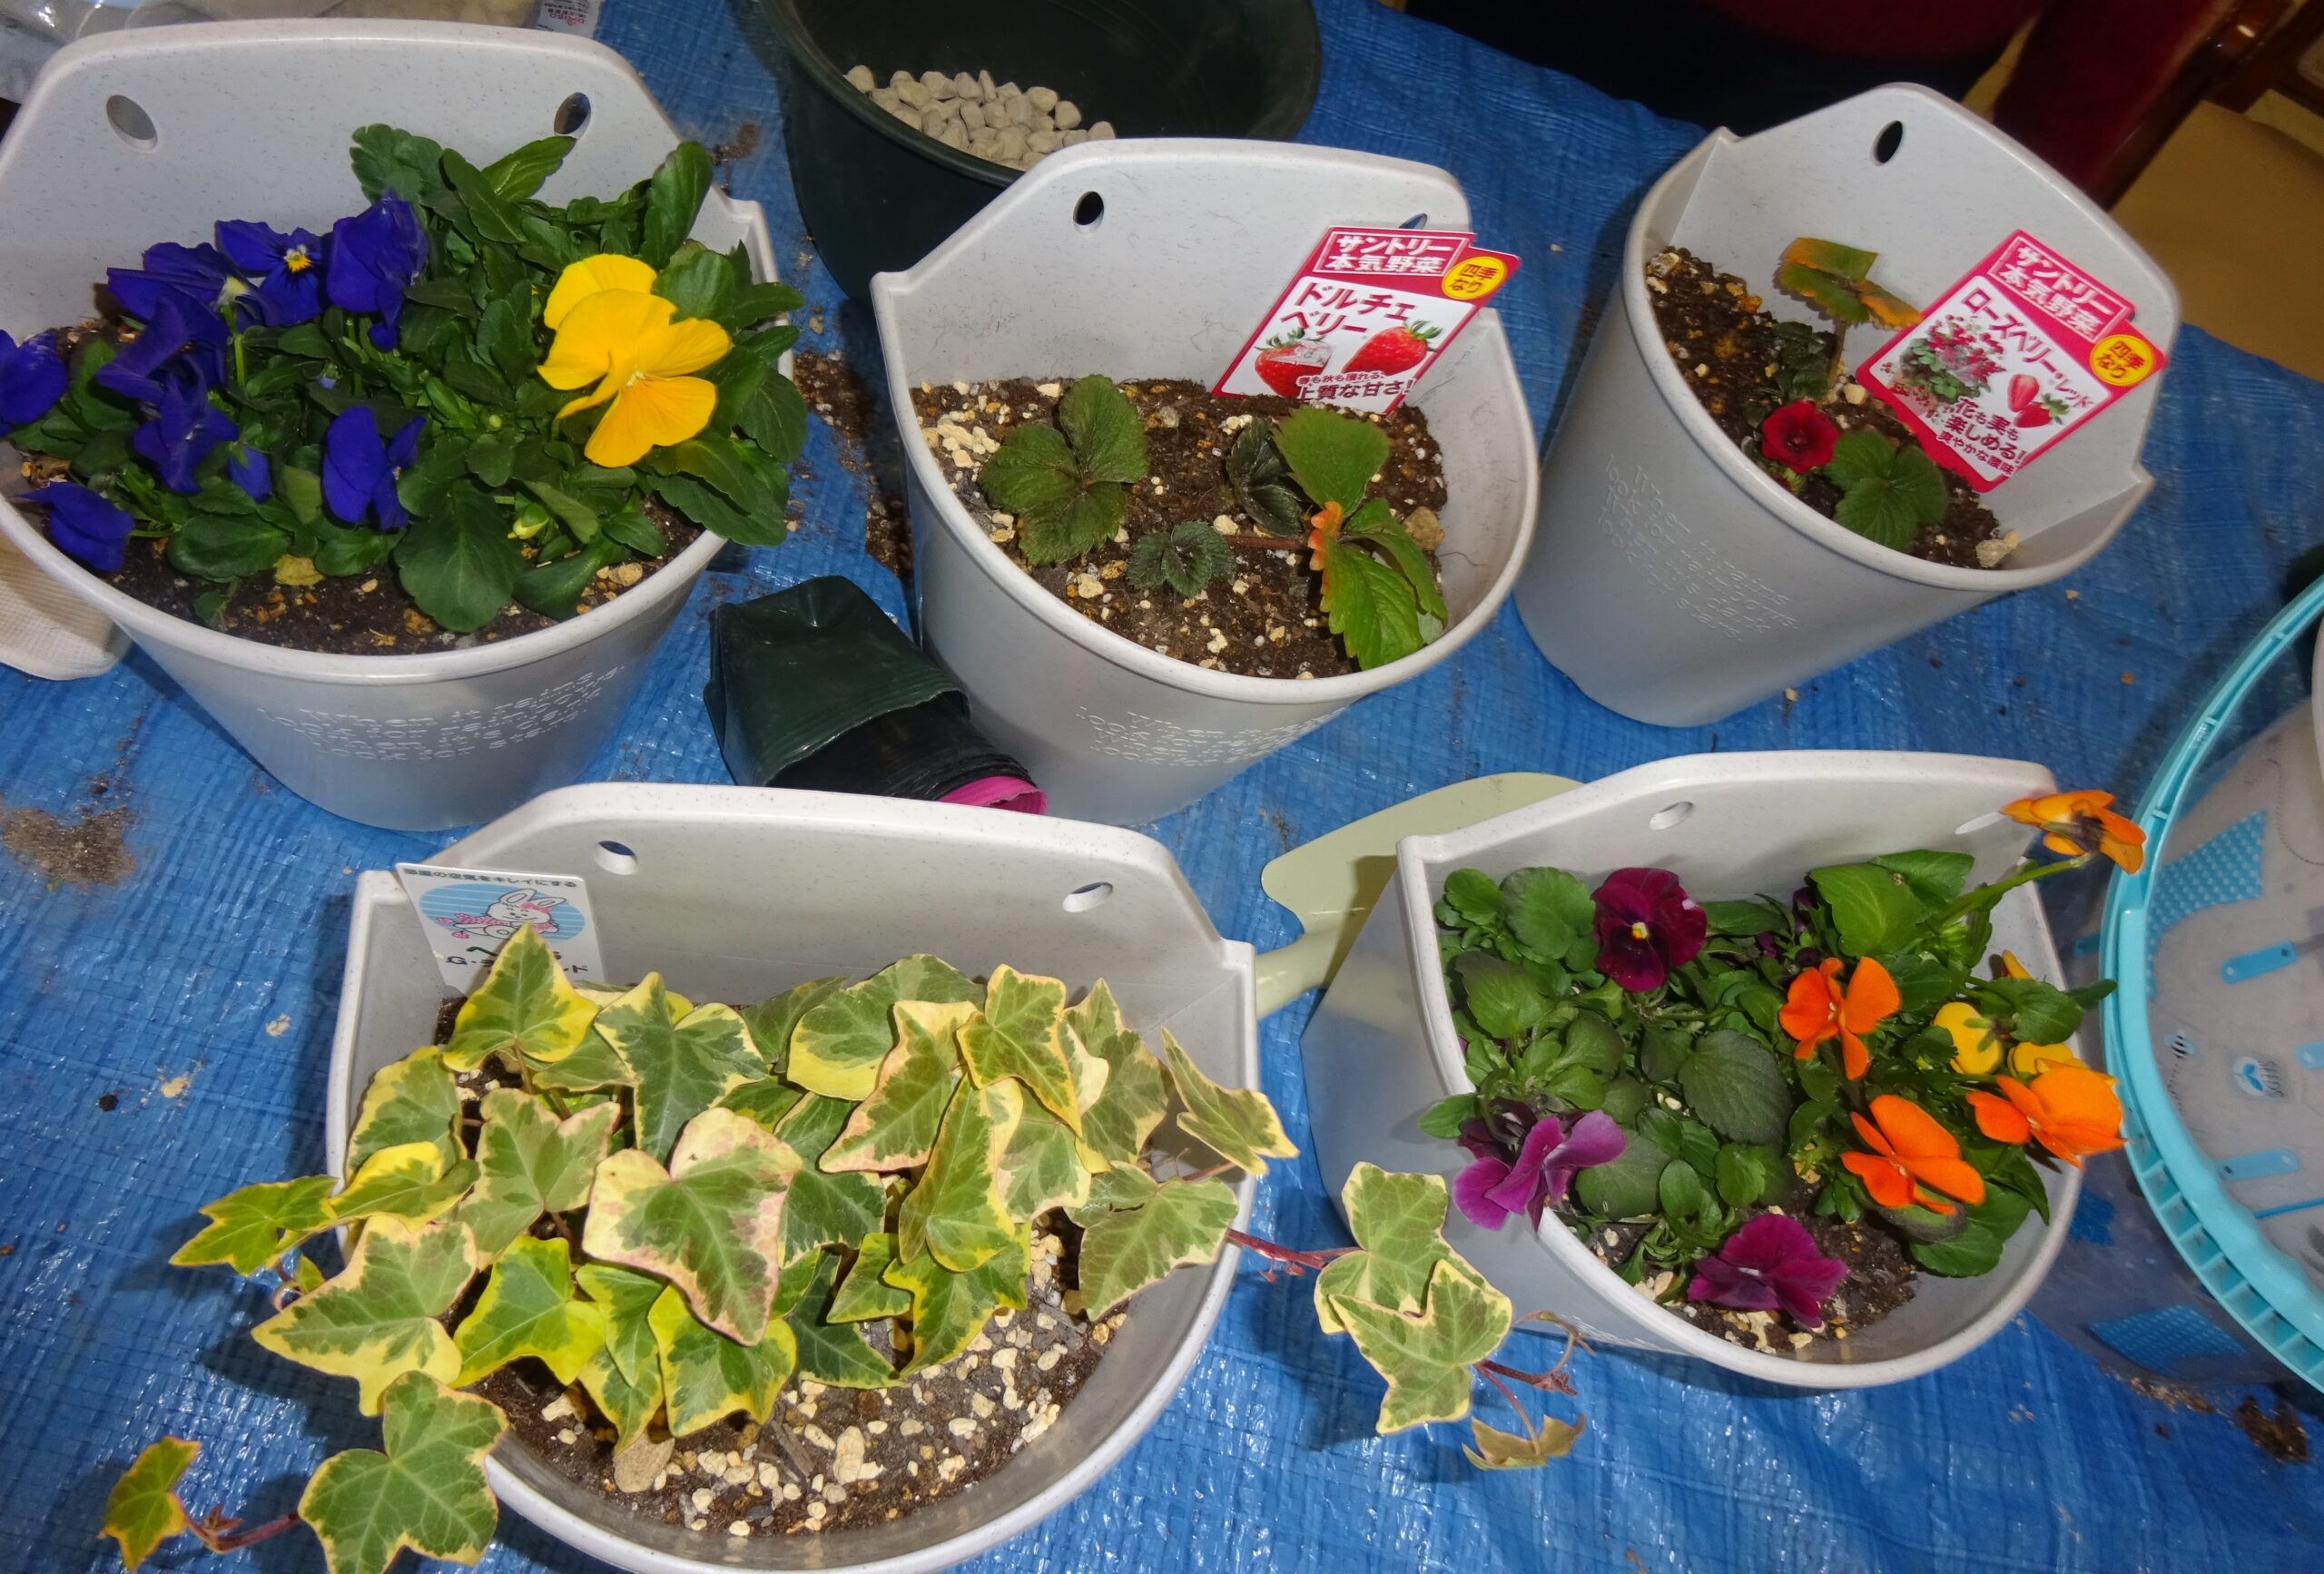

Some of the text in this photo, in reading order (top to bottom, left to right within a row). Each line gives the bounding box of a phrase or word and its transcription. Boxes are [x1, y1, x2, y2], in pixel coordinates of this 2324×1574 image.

[1324, 254, 1447, 274] 本気野菜
[1336, 236, 1454, 256] サントリー
[1295, 281, 1416, 321] ドルチェ
[1999, 264, 2102, 337] 本気野菜
[2014, 246, 2113, 316] サントリー
[1280, 310, 1368, 336] ベリー
[1955, 397, 2020, 440] 花も実も
